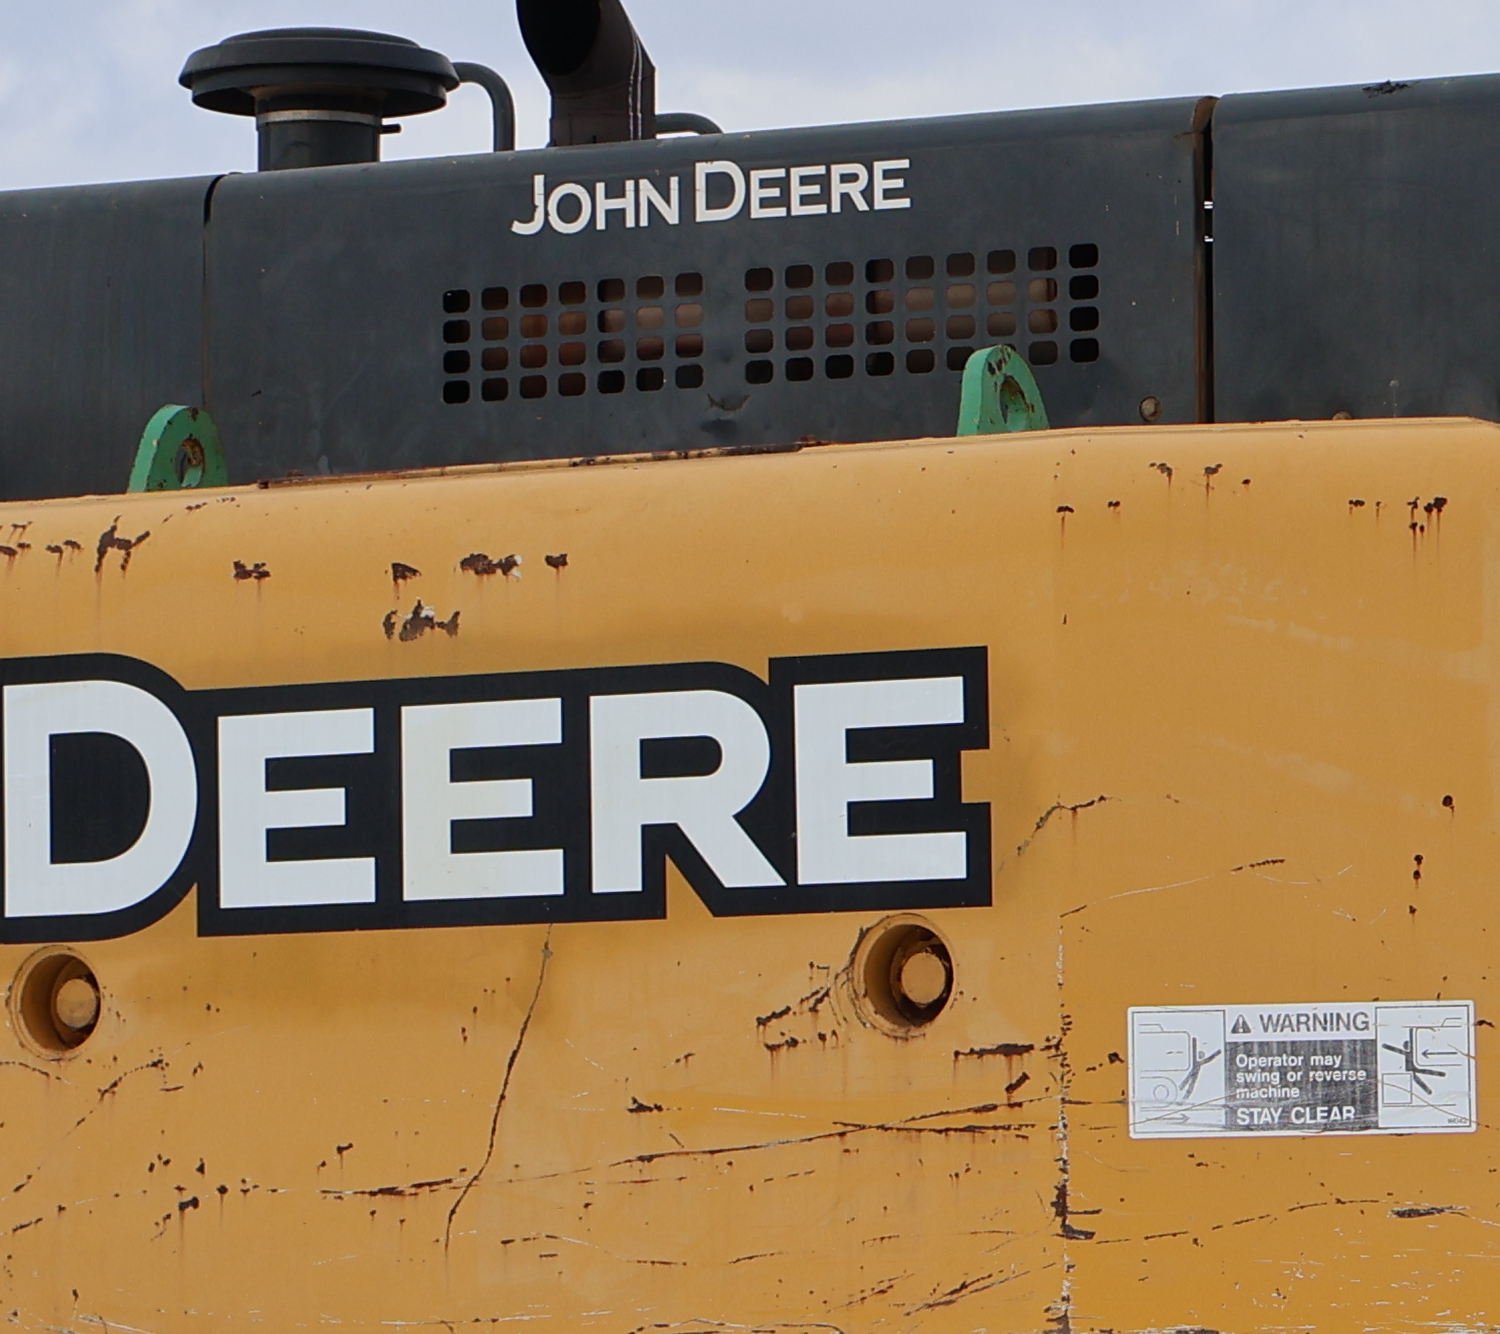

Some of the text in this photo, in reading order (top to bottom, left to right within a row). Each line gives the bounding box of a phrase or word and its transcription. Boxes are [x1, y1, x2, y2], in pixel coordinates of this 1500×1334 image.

[510, 159, 912, 235] JOHN DEERE
[2, 675, 968, 918] DEERE
[1259, 1011, 1370, 1033] WARNING
[1235, 1054, 1342, 1070] Operator may
[1236, 1069, 1367, 1085] swing or reverse
[1236, 1085, 1300, 1099] machine
[1236, 1106, 1356, 1125] STAY CLEAR
